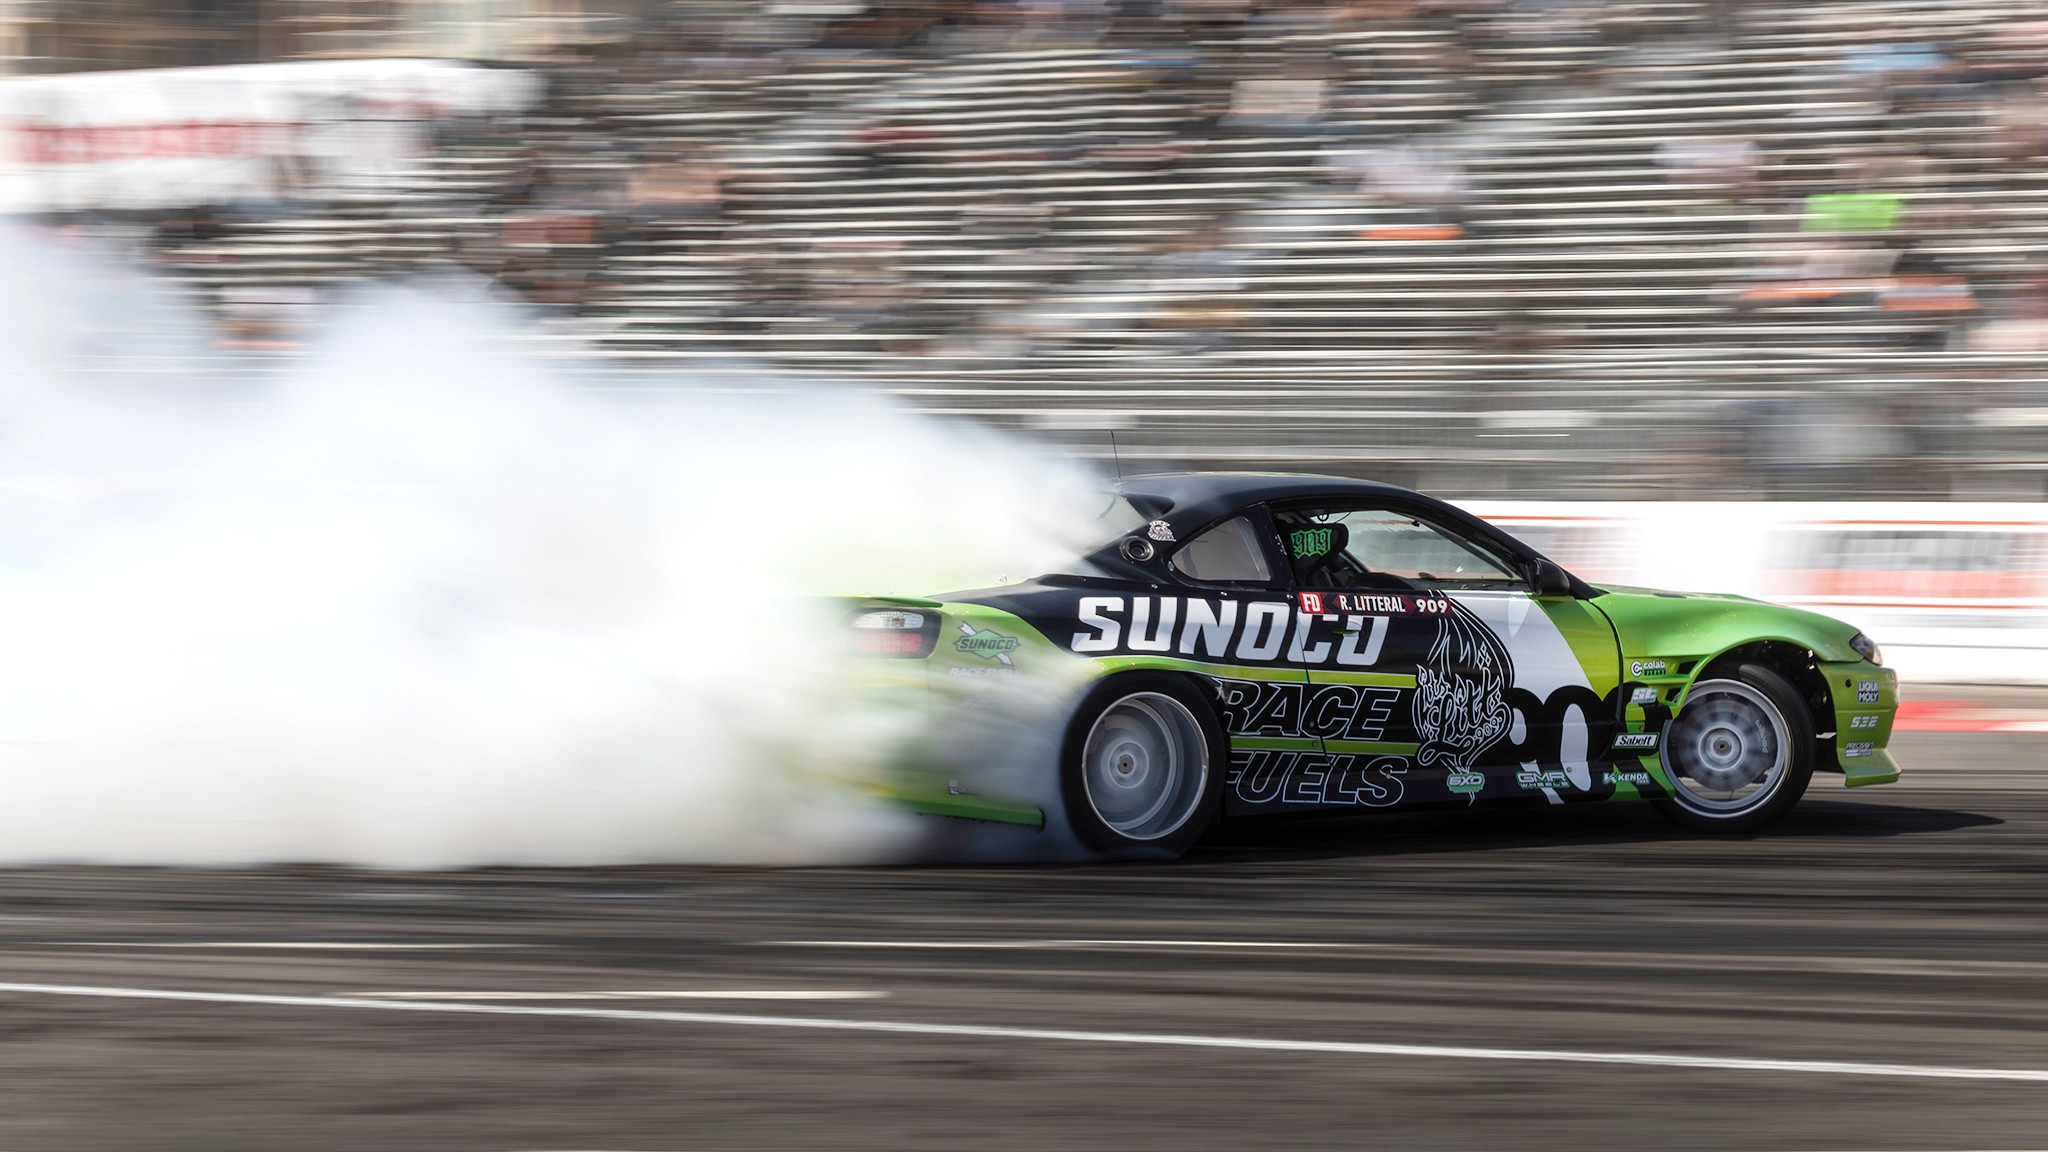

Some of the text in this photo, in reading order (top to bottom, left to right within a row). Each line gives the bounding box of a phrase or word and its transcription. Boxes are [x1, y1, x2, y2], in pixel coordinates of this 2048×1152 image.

[1290, 528, 1333, 560] 909
[1302, 592, 1448, 614] FD R. LITTERAL 909
[1070, 595, 1390, 666] SUNOCO
[959, 638, 1015, 651] SUNOCO
[1643, 660, 1666, 670] colab
[1858, 681, 1879, 692] LIQUI
[1858, 692, 1879, 703] MOLY
[1211, 677, 1401, 741] RACE
[1619, 736, 1653, 746] Sabelt
[1517, 772, 1567, 783] GMR
[1617, 773, 1648, 783] KENDA
